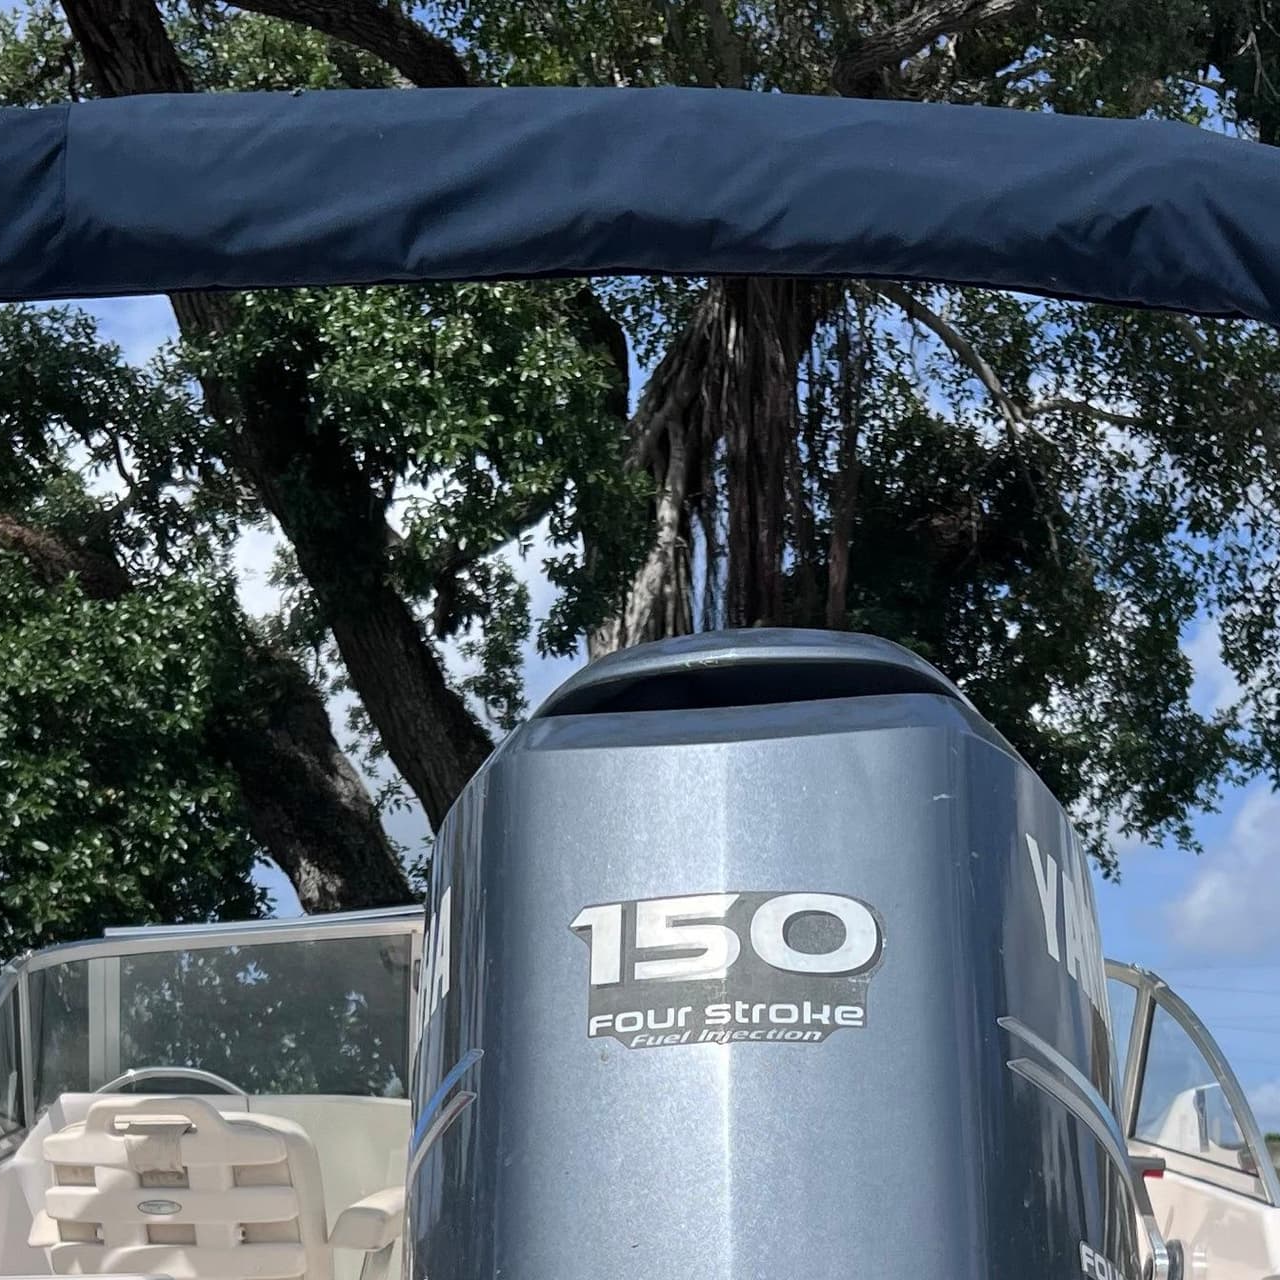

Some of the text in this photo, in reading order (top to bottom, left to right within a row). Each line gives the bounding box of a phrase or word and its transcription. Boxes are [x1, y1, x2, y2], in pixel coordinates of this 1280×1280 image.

[570, 893, 878, 985] 150
[630, 1028, 822, 1047] Fuel Injection
